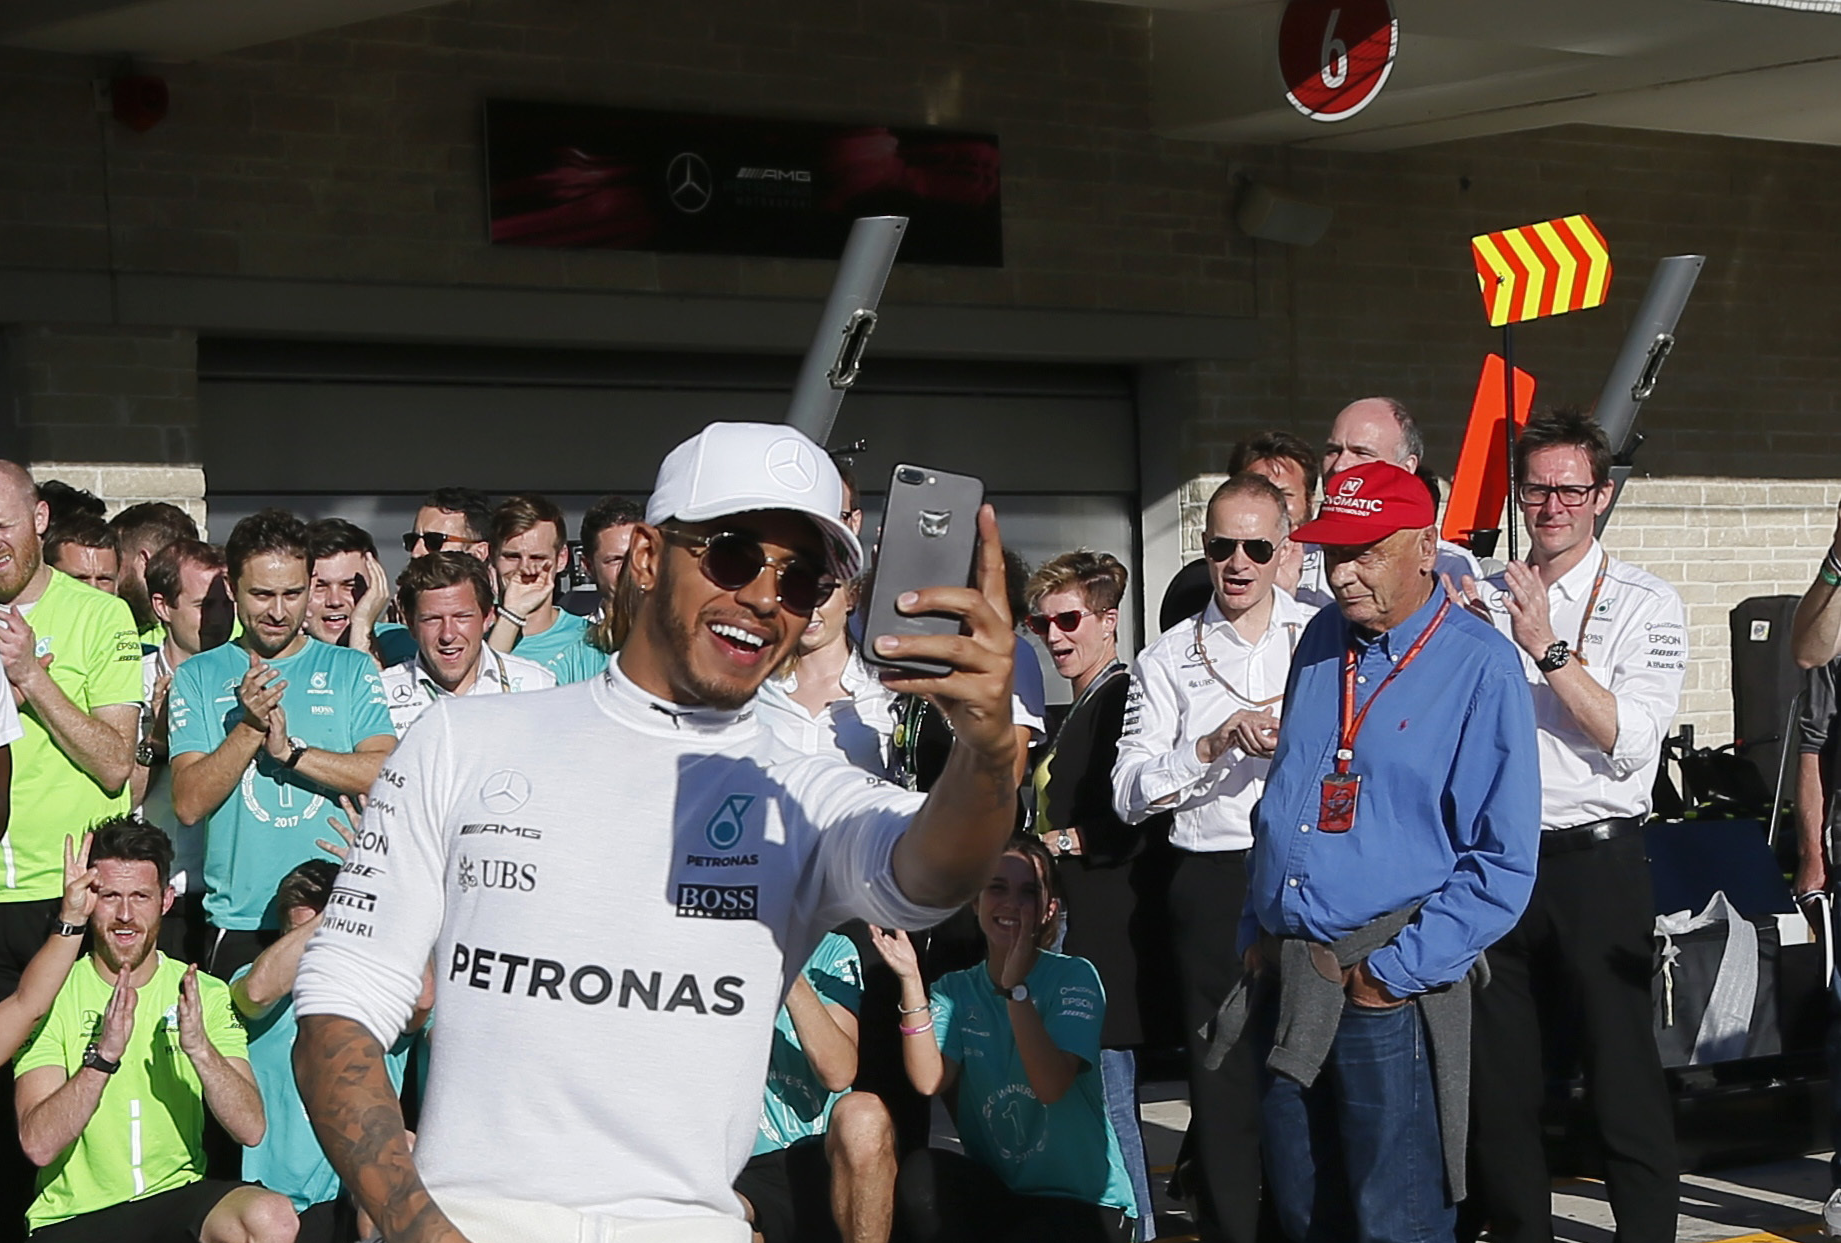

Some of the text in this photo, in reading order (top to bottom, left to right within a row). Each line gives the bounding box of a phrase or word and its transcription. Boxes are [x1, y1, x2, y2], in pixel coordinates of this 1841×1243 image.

[1321, 8, 1348, 89] 6
[1648, 633, 1682, 646] EPSON
[273, 815, 300, 829] 2017
[480, 824, 543, 841] AMG
[686, 854, 759, 869] PETRONAS
[480, 858, 538, 893] UBS
[680, 886, 756, 911] BOSS
[449, 941, 746, 1018] PETRONAS
[1061, 997, 1095, 1011] EPSON
